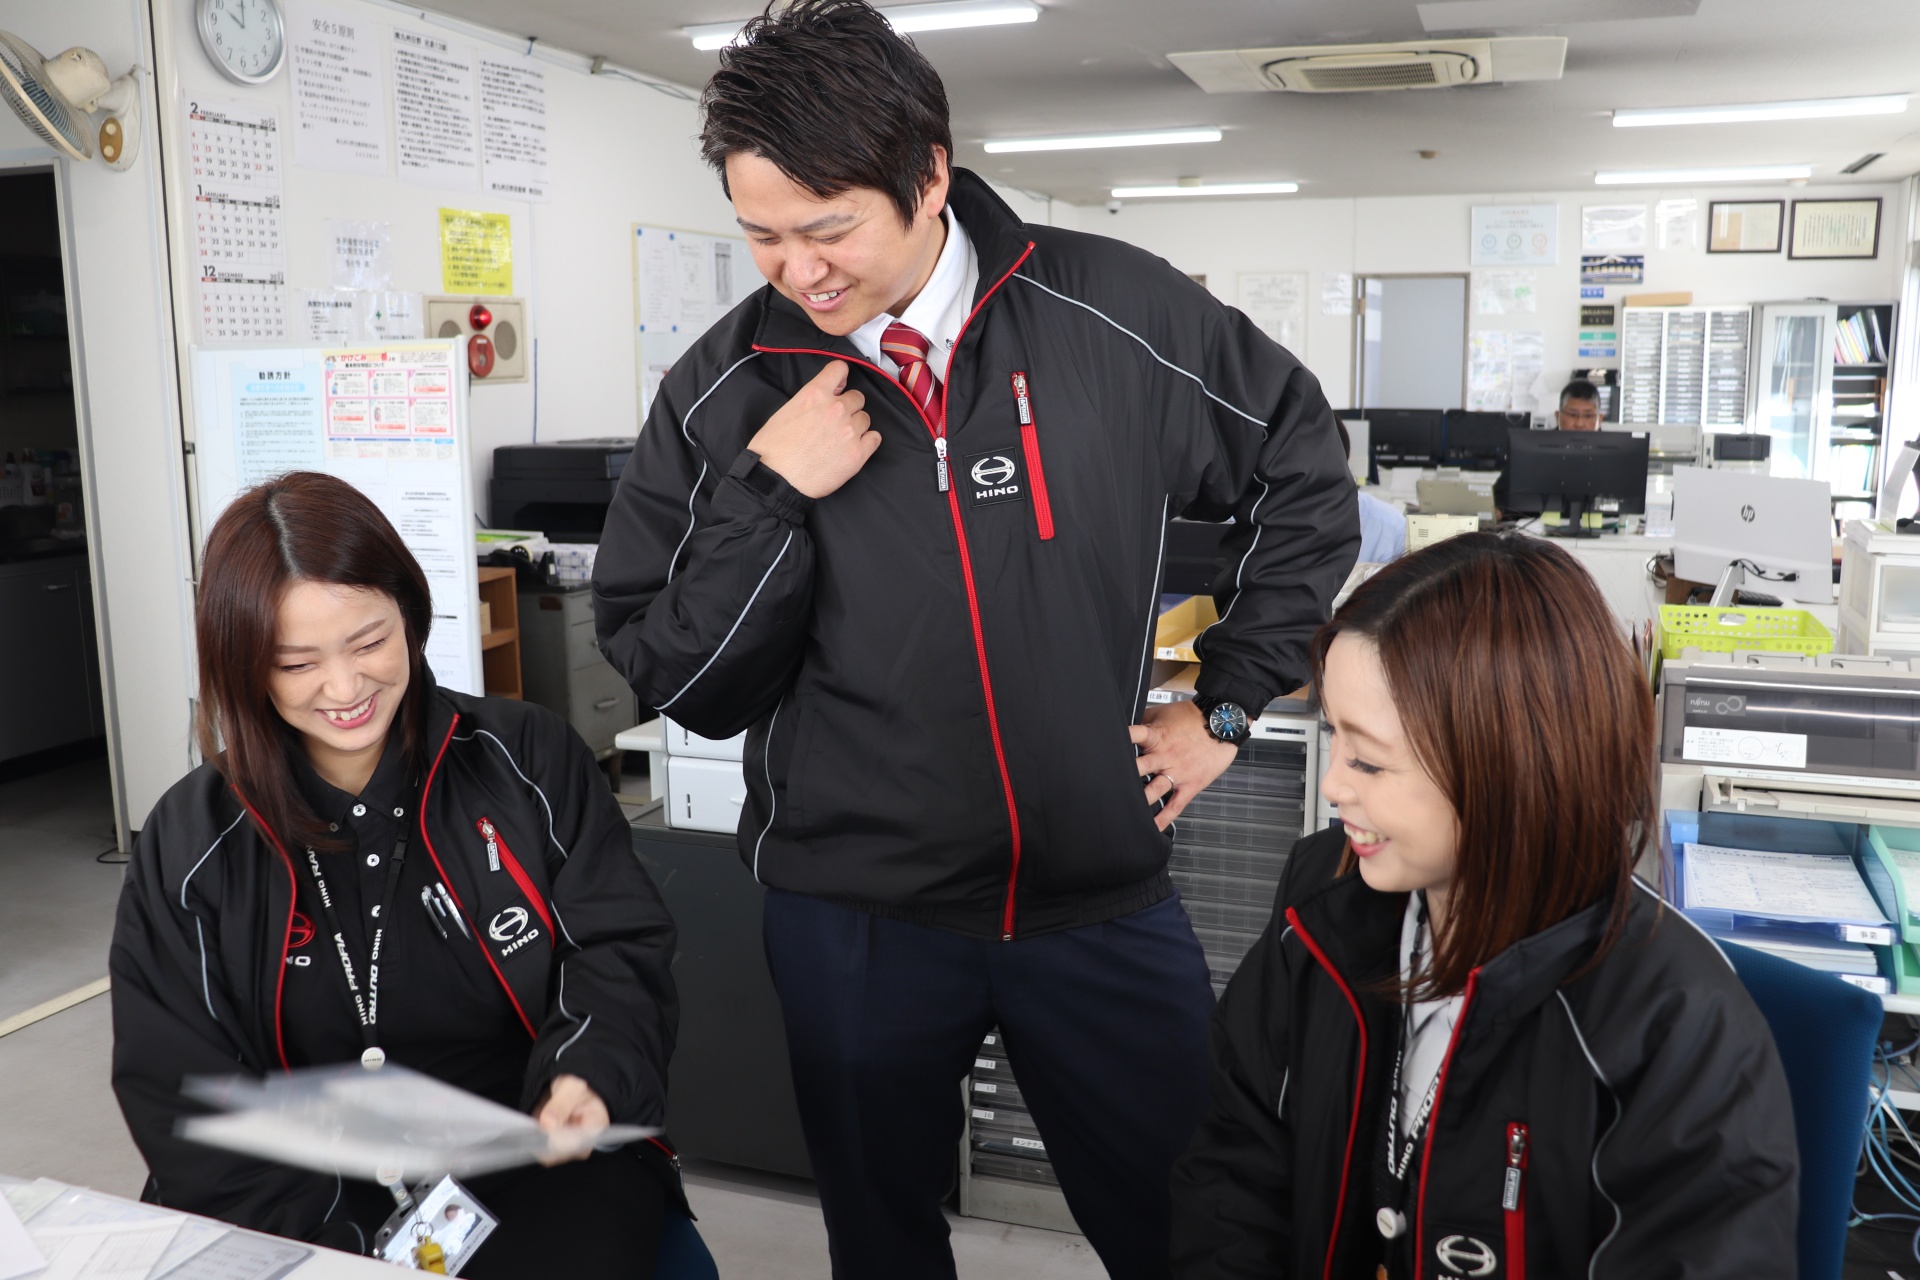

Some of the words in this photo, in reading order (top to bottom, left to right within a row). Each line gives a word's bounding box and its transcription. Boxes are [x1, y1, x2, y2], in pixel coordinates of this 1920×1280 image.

[211, 12, 218, 25] 9
[260, 10, 267, 22] 2
[216, 33, 223, 46] 8
[265, 28, 271, 40] 3
[227, 47, 233, 61] 7
[261, 45, 267, 57] 4
[240, 56, 247, 69] 6
[253, 54, 259, 67] 5
[200, 110, 226, 119] FEBRUARY
[259, 371, 291, 380] 勧誘方針
[976, 486, 1019, 499] HINO
[1741, 504, 1755, 522] hp
[1690, 697, 1711, 707] FUJITSU
[318, 880, 331, 908] HINO
[372, 928, 383, 960] HINO
[501, 928, 540, 957] HINO
[333, 932, 359, 991] PROFIA
[368, 964, 378, 1025] DUTRO
[355, 994, 369, 1026] HINO
[1387, 1096, 1398, 1175] DUTRO
[1396, 1142, 1414, 1180] HINO
